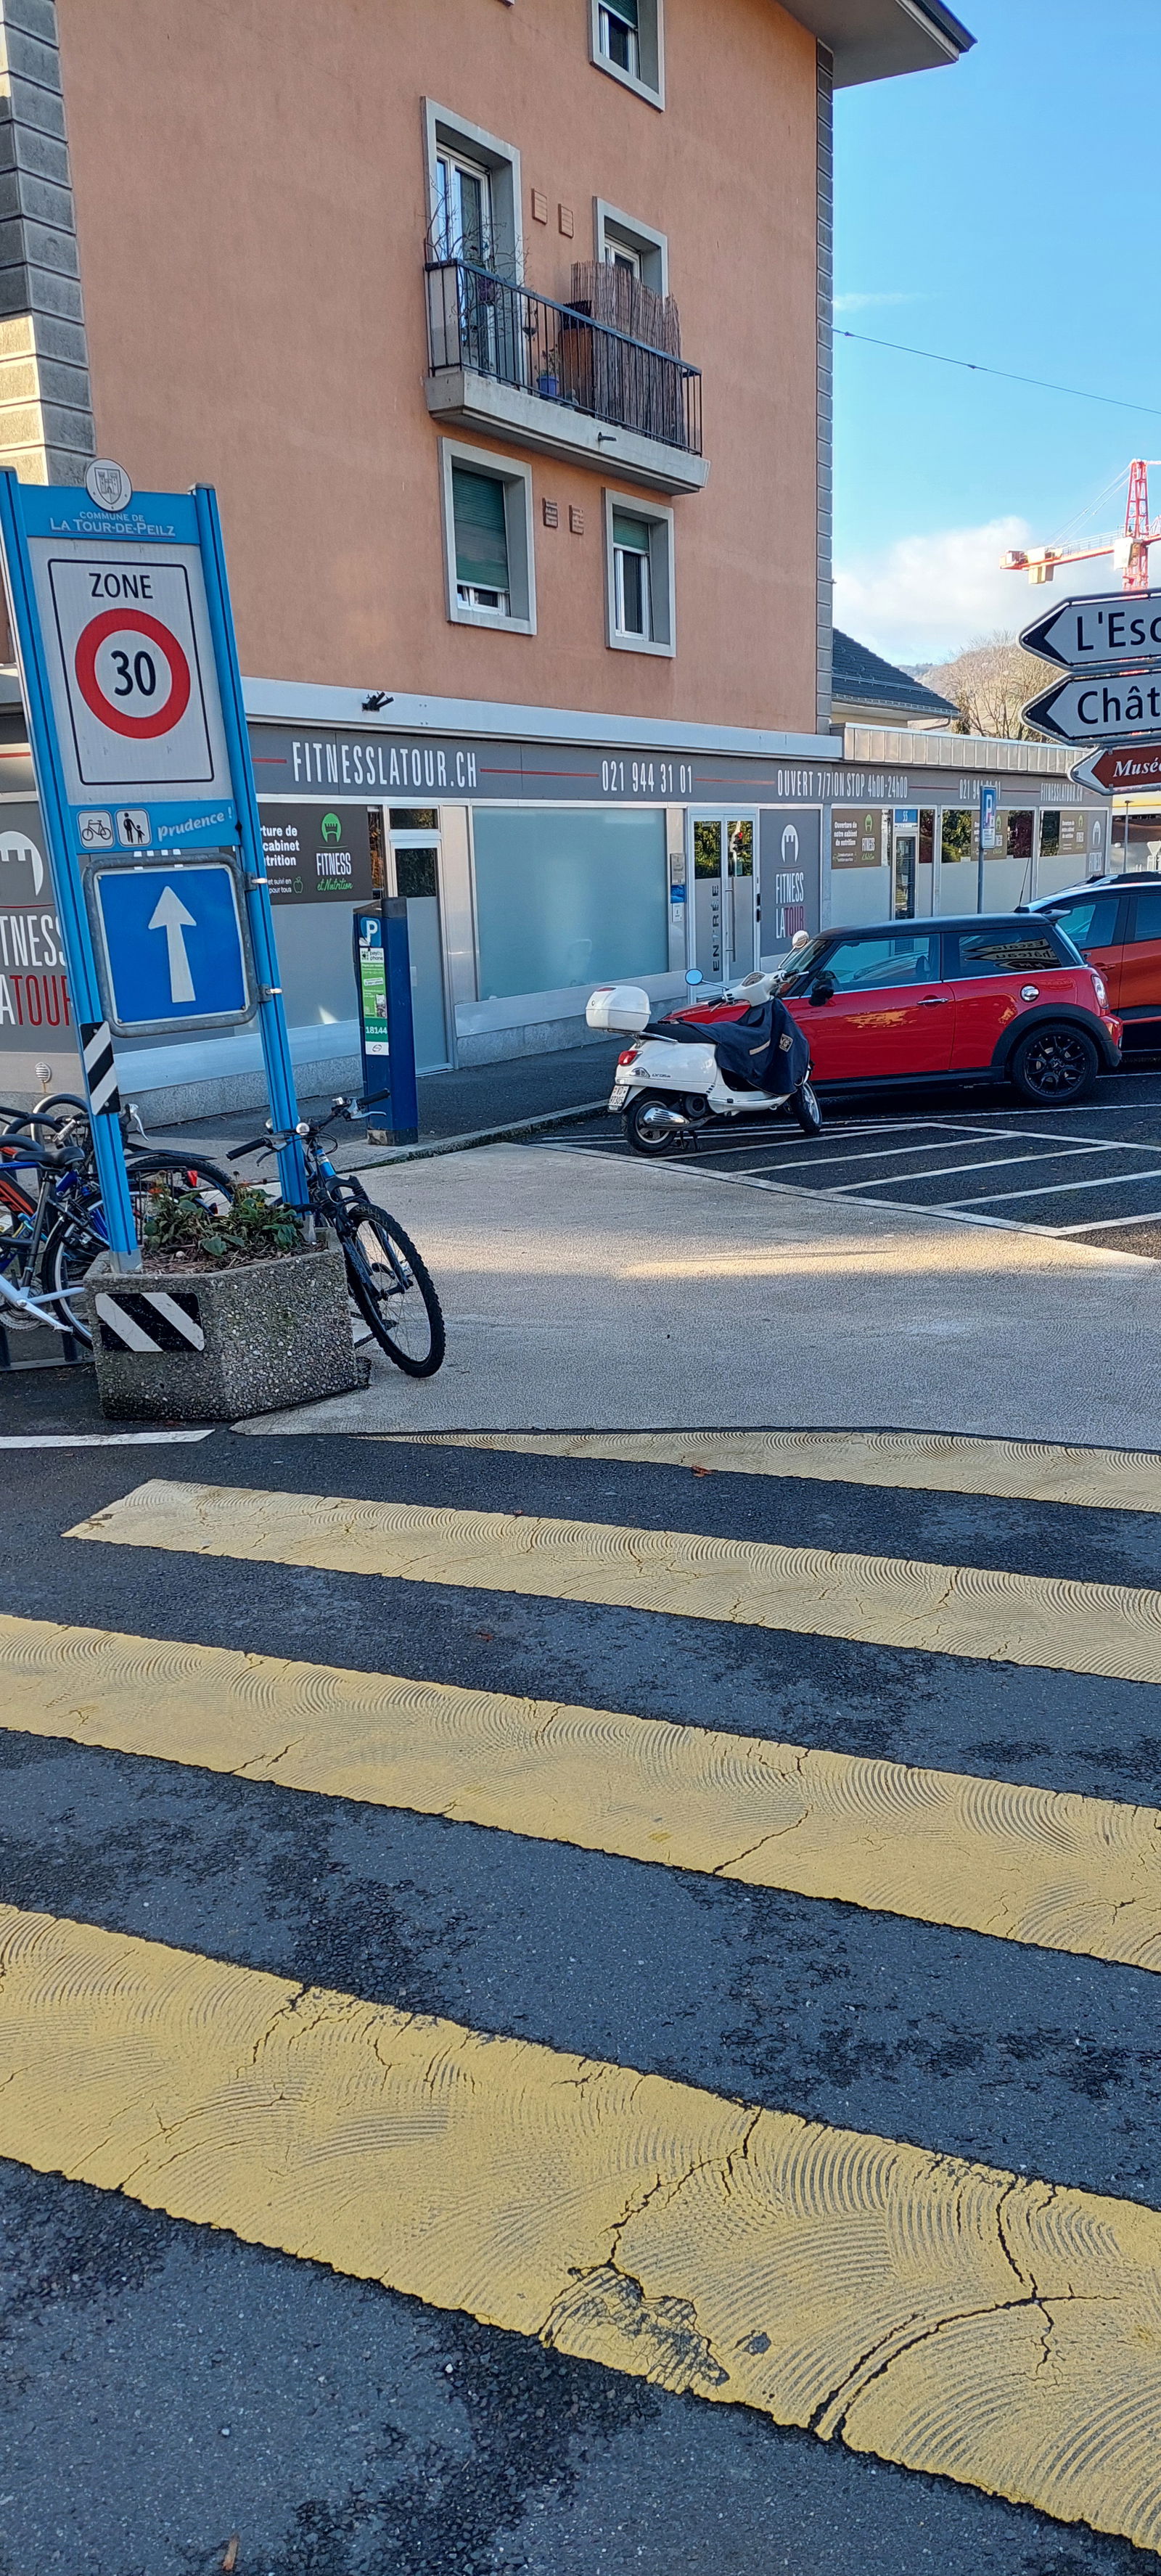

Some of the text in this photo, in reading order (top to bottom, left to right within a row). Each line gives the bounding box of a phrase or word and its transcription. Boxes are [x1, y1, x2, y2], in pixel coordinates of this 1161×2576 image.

[79, 512, 129, 522] COMMUNE
[89, 573, 154, 599] ZONE
[110, 650, 156, 697] 30
[1077, 685, 1161, 725] Chât
[292, 741, 477, 788] FITNESSLATOUR.CH
[602, 760, 692, 794] 021 944 31 01
[777, 769, 813, 797] OUVERT
[817, 771, 831, 800] 7/7
[846, 772, 865, 797] STOP
[959, 779, 970, 800] 021
[260, 825, 298, 837] ture de
[263, 840, 300, 852] cabinet
[264, 855, 296, 866] trition
[316, 852, 352, 876] FITNESS
[317, 877, 354, 891] et Nutrition
[776, 871, 804, 905] FITNESS
